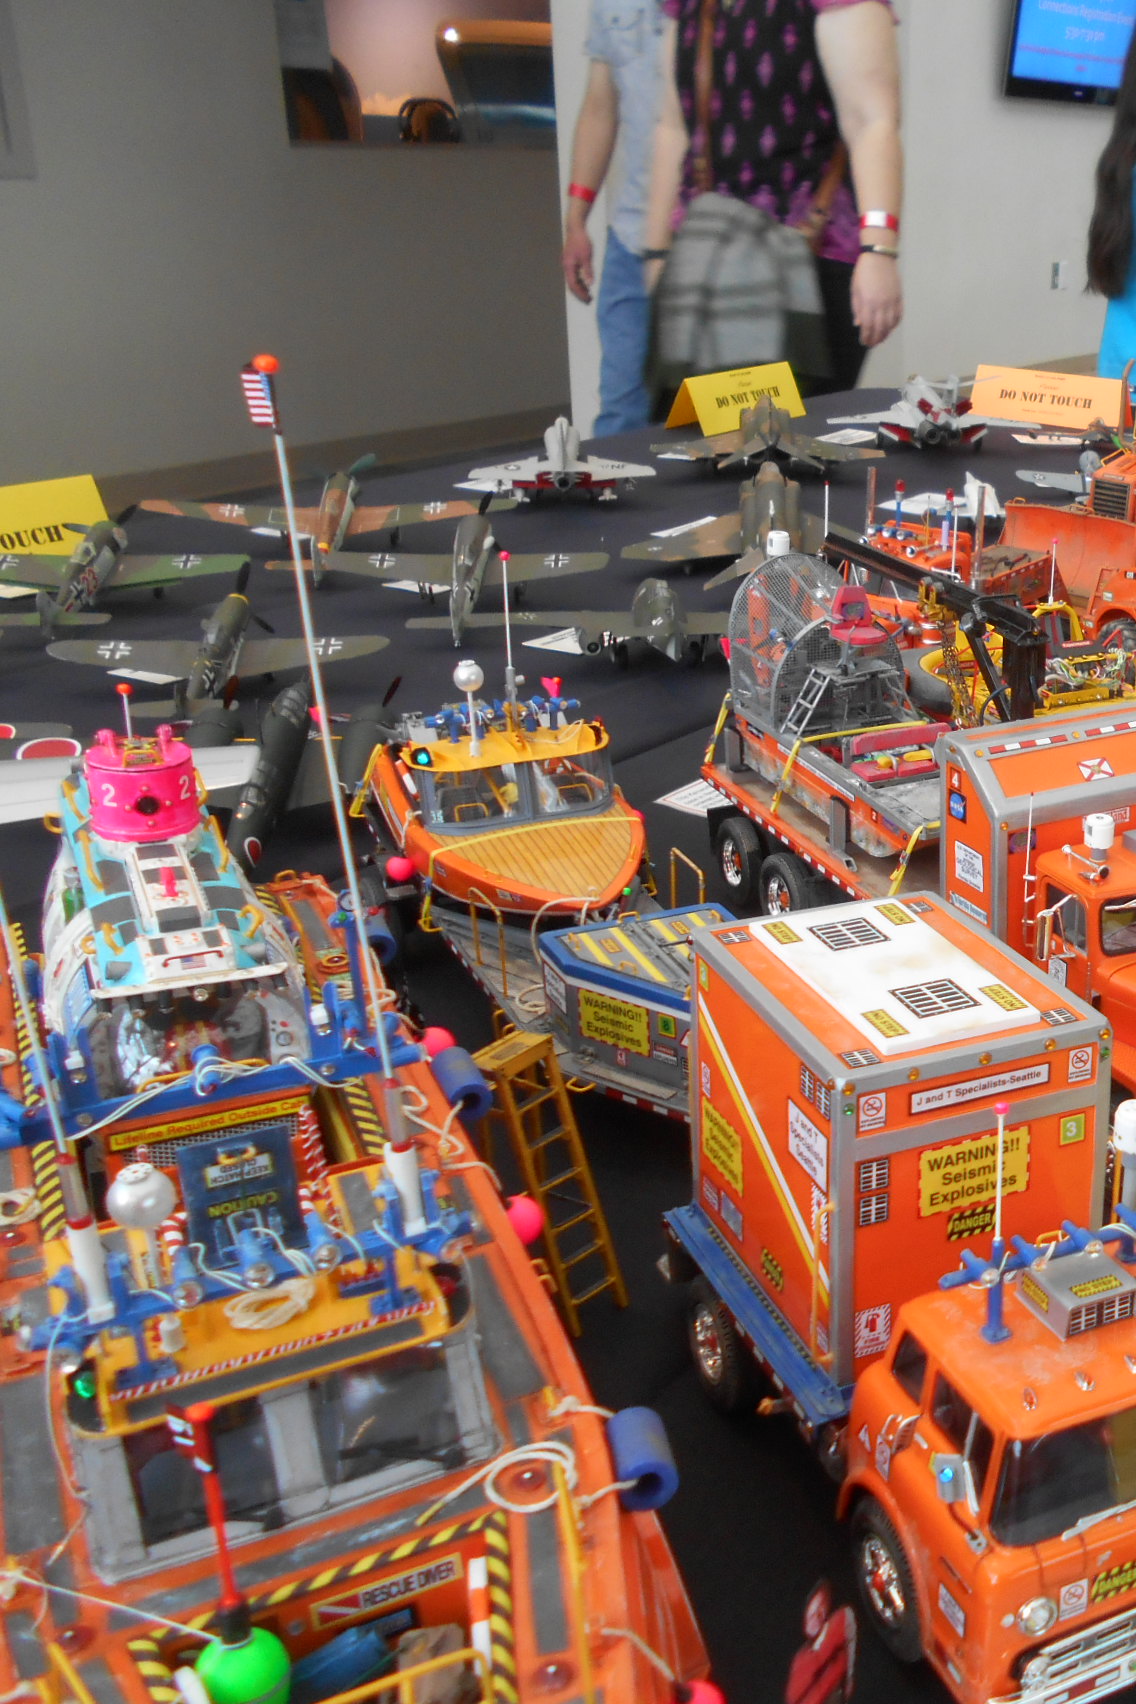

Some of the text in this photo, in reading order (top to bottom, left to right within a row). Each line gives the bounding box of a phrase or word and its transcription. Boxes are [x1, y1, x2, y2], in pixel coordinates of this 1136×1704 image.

[715, 395, 730, 409] DO
[730, 392, 749, 405] NOT
[999, 388, 1093, 409] DO NOT TOUCH
[179, 775, 191, 800] 2
[951, 772, 959, 788] 4
[101, 783, 118, 808] 2
[584, 995, 643, 1022] WARNING!!
[586, 1021, 643, 1048] Explosives
[593, 1011, 635, 1033] Seismic
[873, 1012, 899, 1033] NO STEP
[917, 1070, 1042, 1106] J and T Specialists-Seattle
[115, 1097, 305, 1148] Lifeline Required Outside Cab
[795, 1113, 800, 1123] J
[801, 1120, 813, 1138] and
[1066, 1121, 1077, 1137] 3
[790, 1120, 824, 1167] Specialists
[927, 1137, 1021, 1172] WARNING!!
[796, 1143, 817, 1176] Seattle
[941, 1160, 1007, 1187] Seismic
[929, 1174, 1018, 1208] Explosives
[953, 1211, 992, 1233] DANGER
[362, 1561, 456, 1608] RESCUE DIVER
